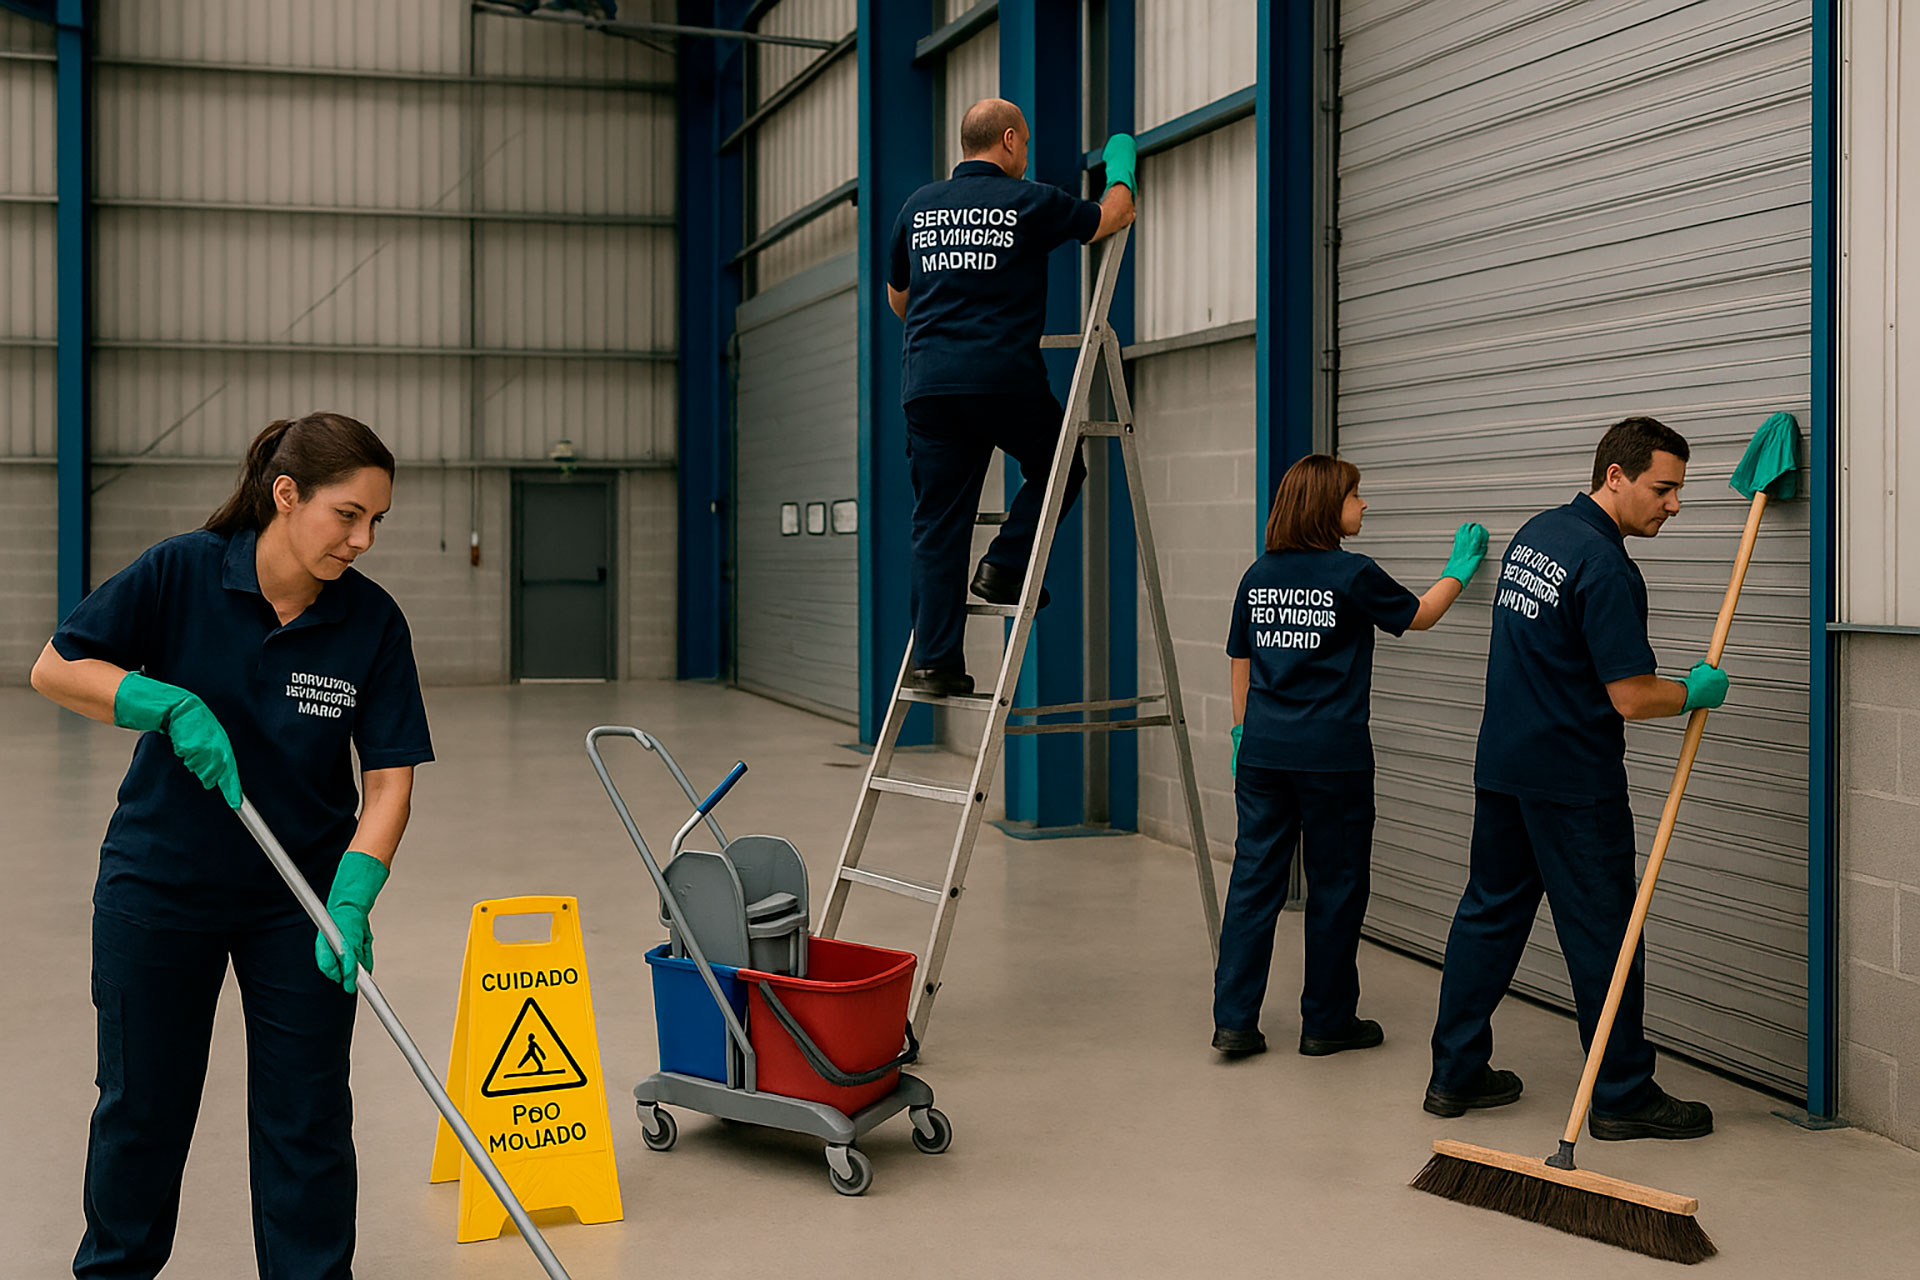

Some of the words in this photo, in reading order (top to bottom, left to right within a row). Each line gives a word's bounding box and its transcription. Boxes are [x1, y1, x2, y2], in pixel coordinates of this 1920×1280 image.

[912, 207, 1018, 229] SERVICIOS
[921, 251, 997, 273] MADRID
[1247, 588, 1334, 607] SERVICIOS
[1256, 630, 1321, 649] MADRID
[298, 701, 342, 718] MARIO
[481, 967, 579, 992] CUIDADO
[489, 1121, 587, 1153] MOJADO
